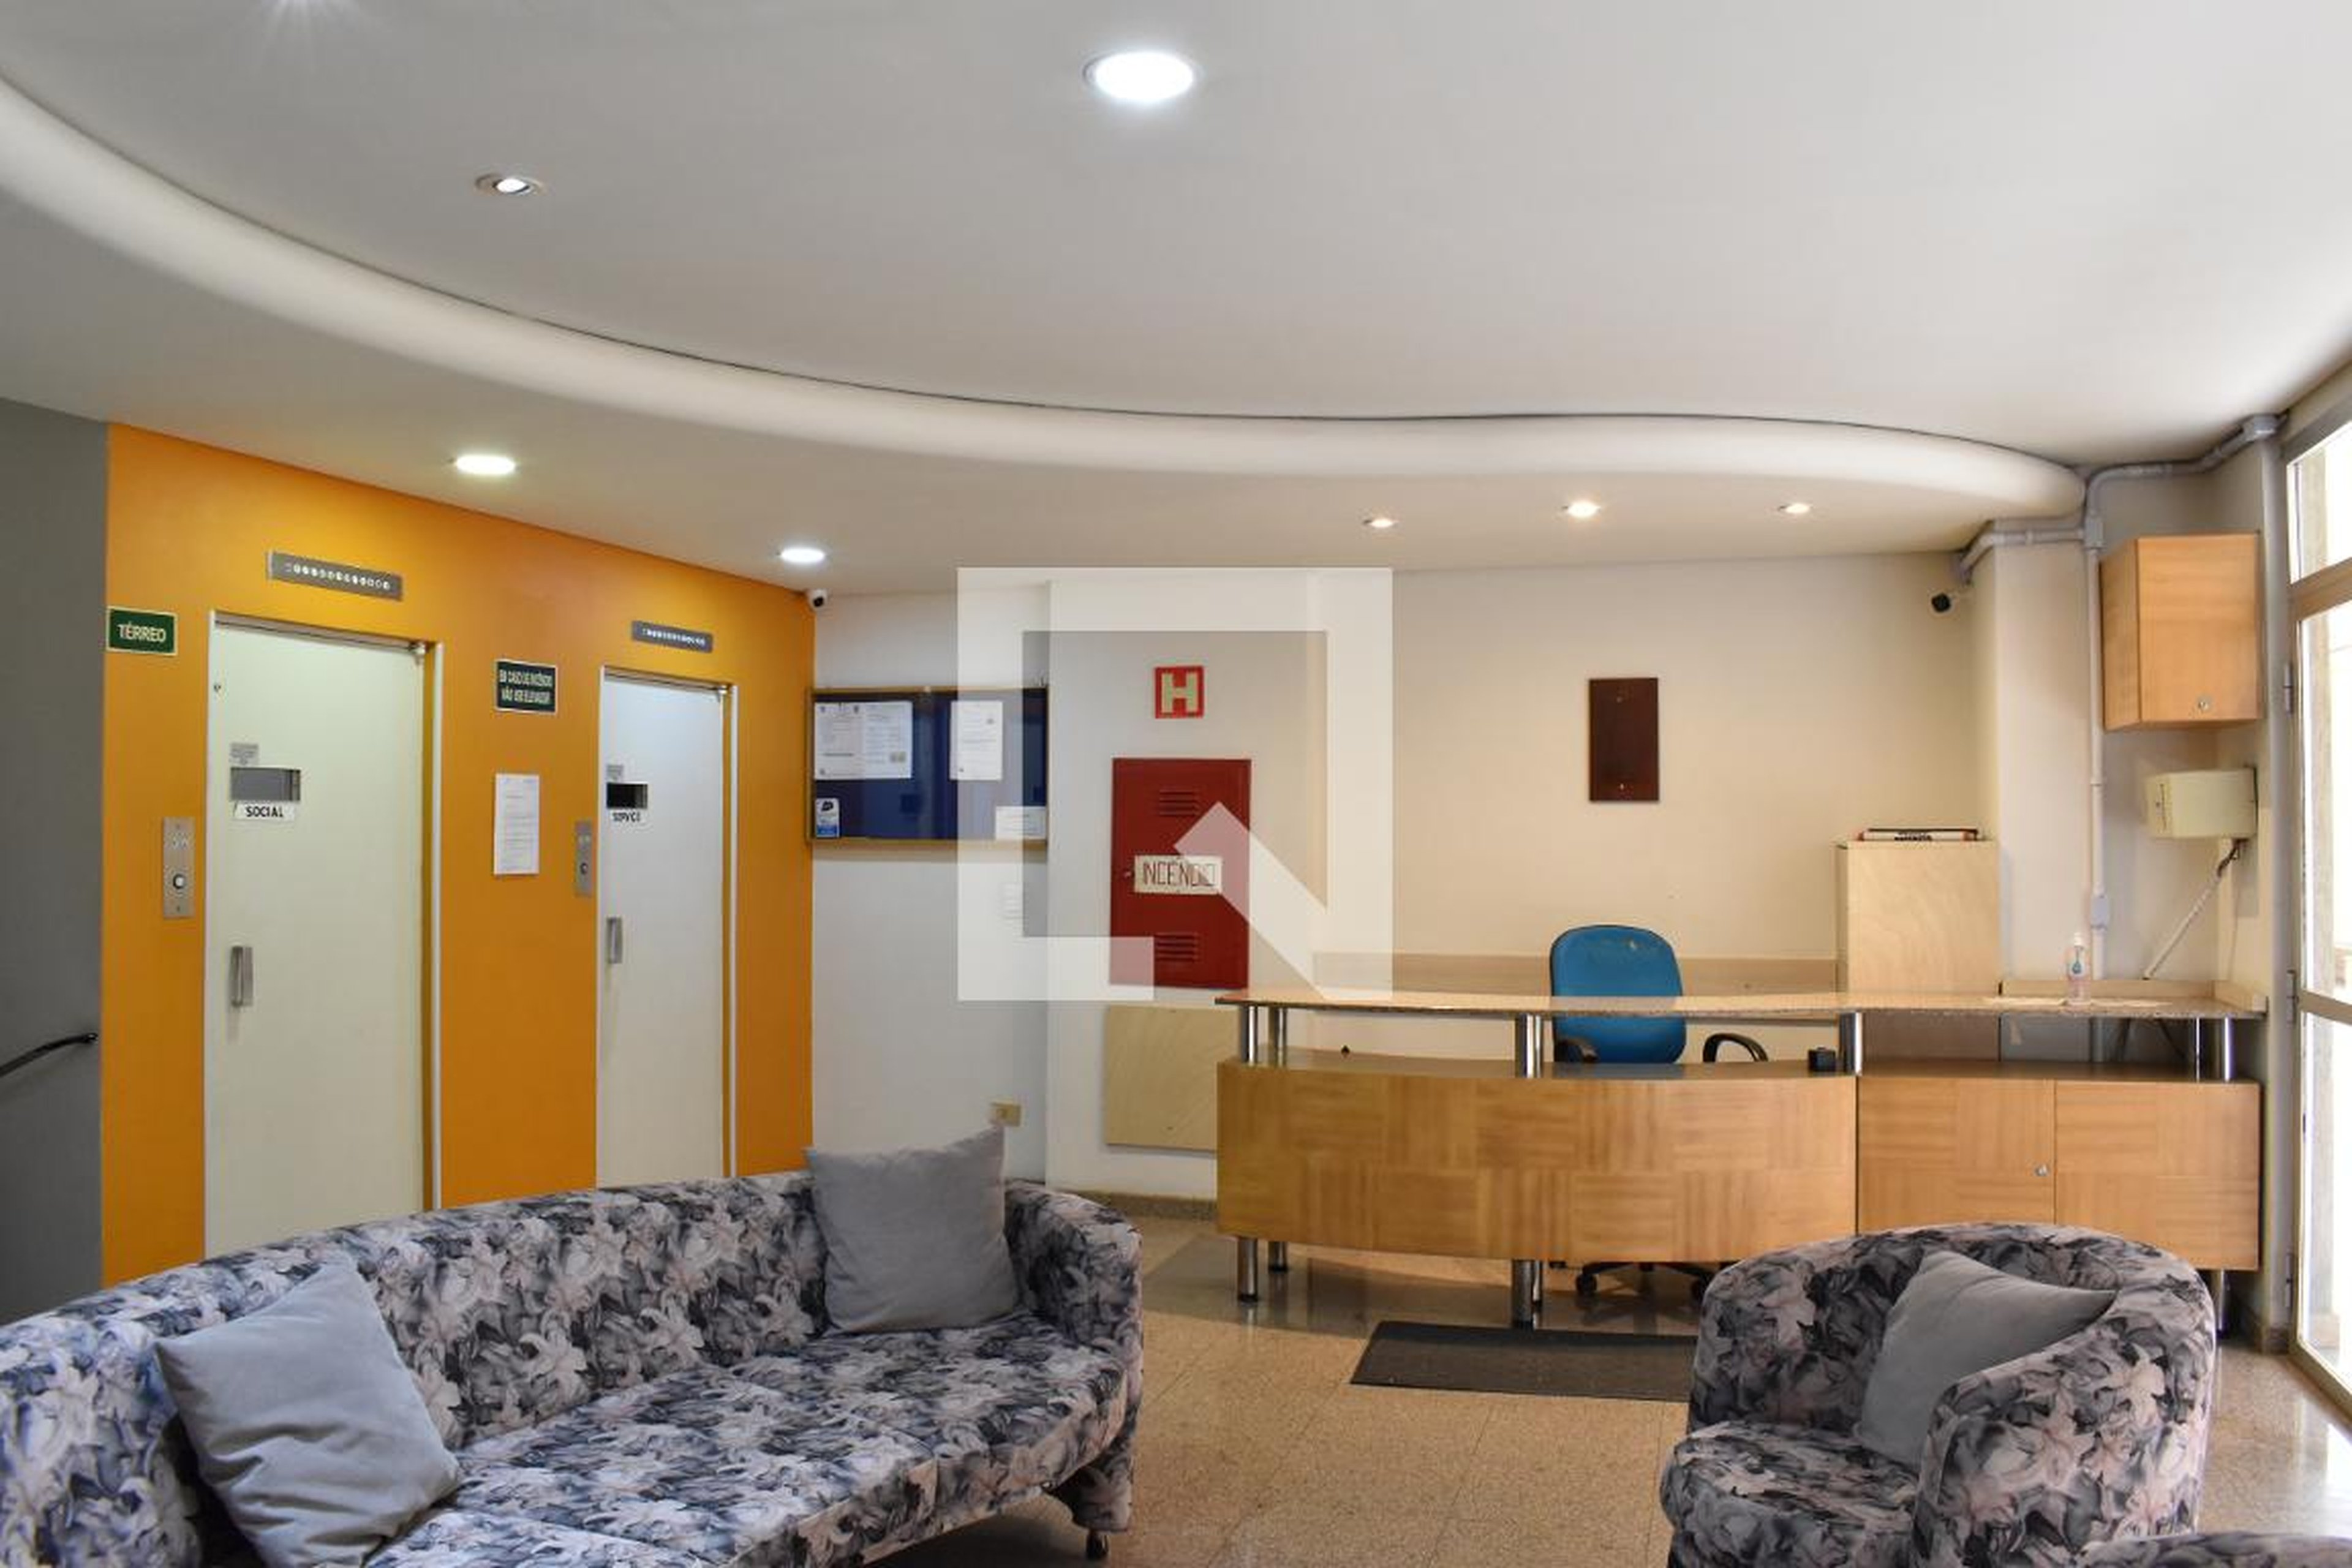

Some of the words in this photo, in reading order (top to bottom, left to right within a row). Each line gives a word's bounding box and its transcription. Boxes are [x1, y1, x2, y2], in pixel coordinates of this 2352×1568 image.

[118, 620, 167, 643] TÉRREO
[1161, 673, 1199, 712] H
[245, 805, 284, 818] SOCIAL
